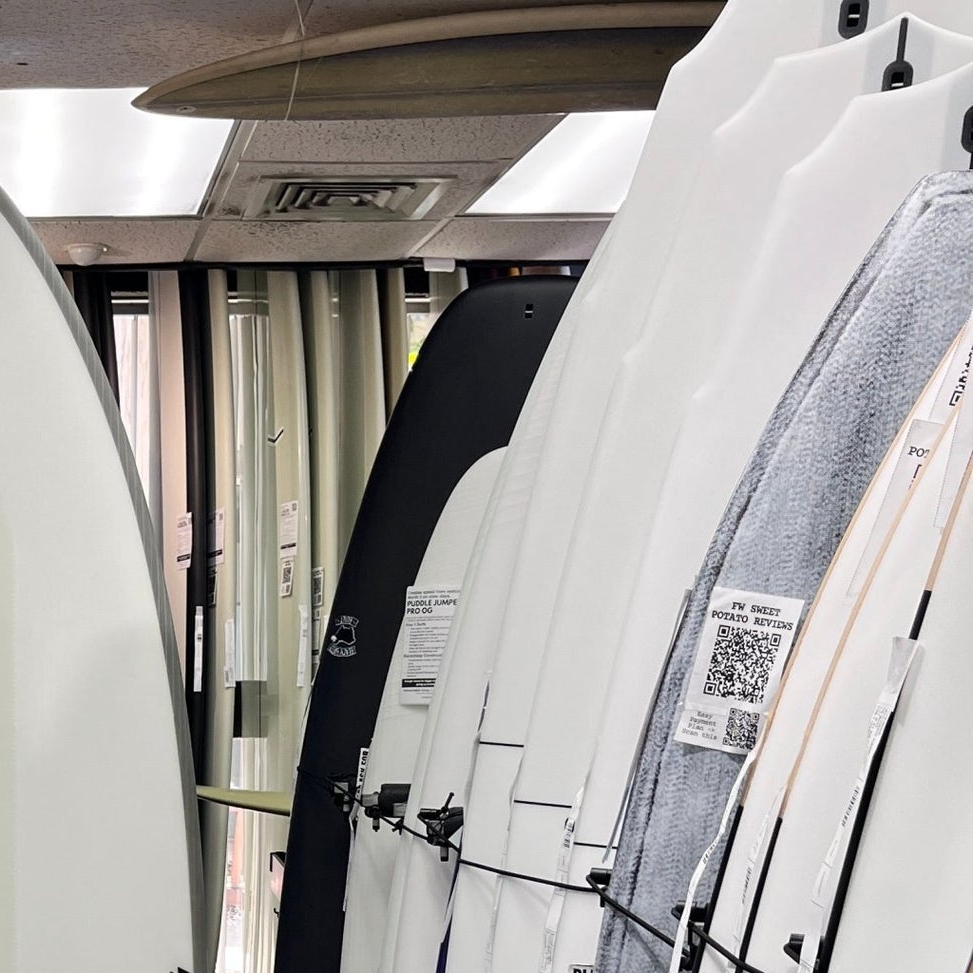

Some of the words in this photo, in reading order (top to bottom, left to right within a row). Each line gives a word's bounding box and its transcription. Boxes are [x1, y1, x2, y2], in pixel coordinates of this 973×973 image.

[407, 599, 432, 607] PUDDLE
[407, 607, 421, 615] PRO
[731, 602, 746, 611] FW
[750, 604, 781, 617] SWEET
[711, 610, 749, 624] POTATO
[753, 618, 794, 631] REVIEWS
